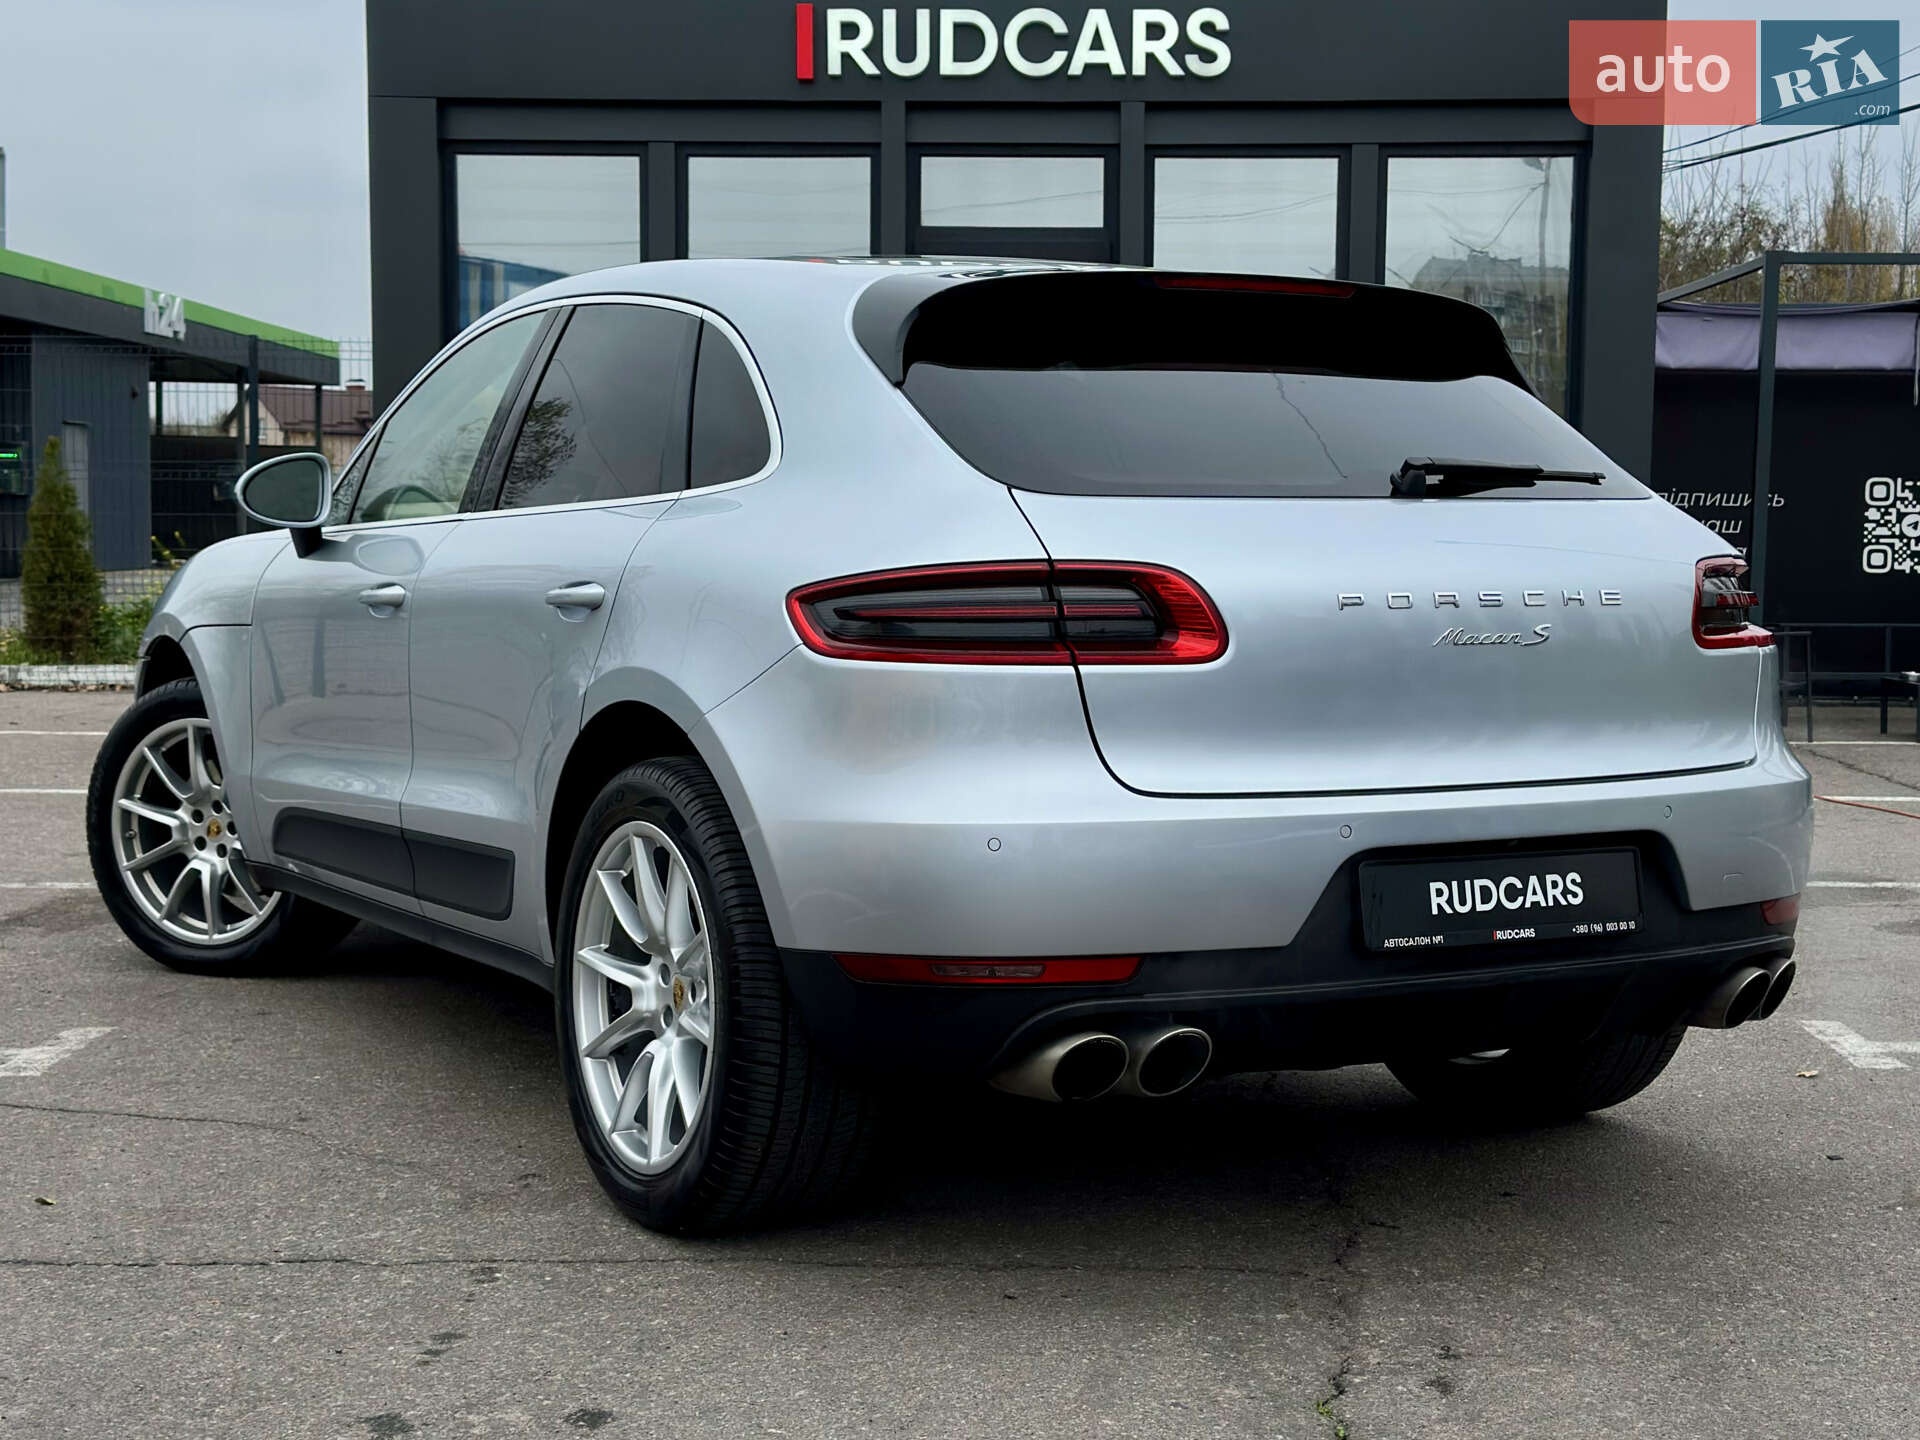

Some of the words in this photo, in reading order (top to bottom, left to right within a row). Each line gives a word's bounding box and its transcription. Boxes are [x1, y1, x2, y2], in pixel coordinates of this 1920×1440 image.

[826, 7, 1232, 77] RUDCARS
[1337, 589, 1623, 610] PORSCHE
[1432, 627, 1522, 647] Macan
[1521, 623, 1552, 646] S
[1429, 872, 1584, 915] RUDCARS
[1384, 936, 1431, 948] АВТОСАЛОН
[1496, 928, 1536, 940] RUDCARS
